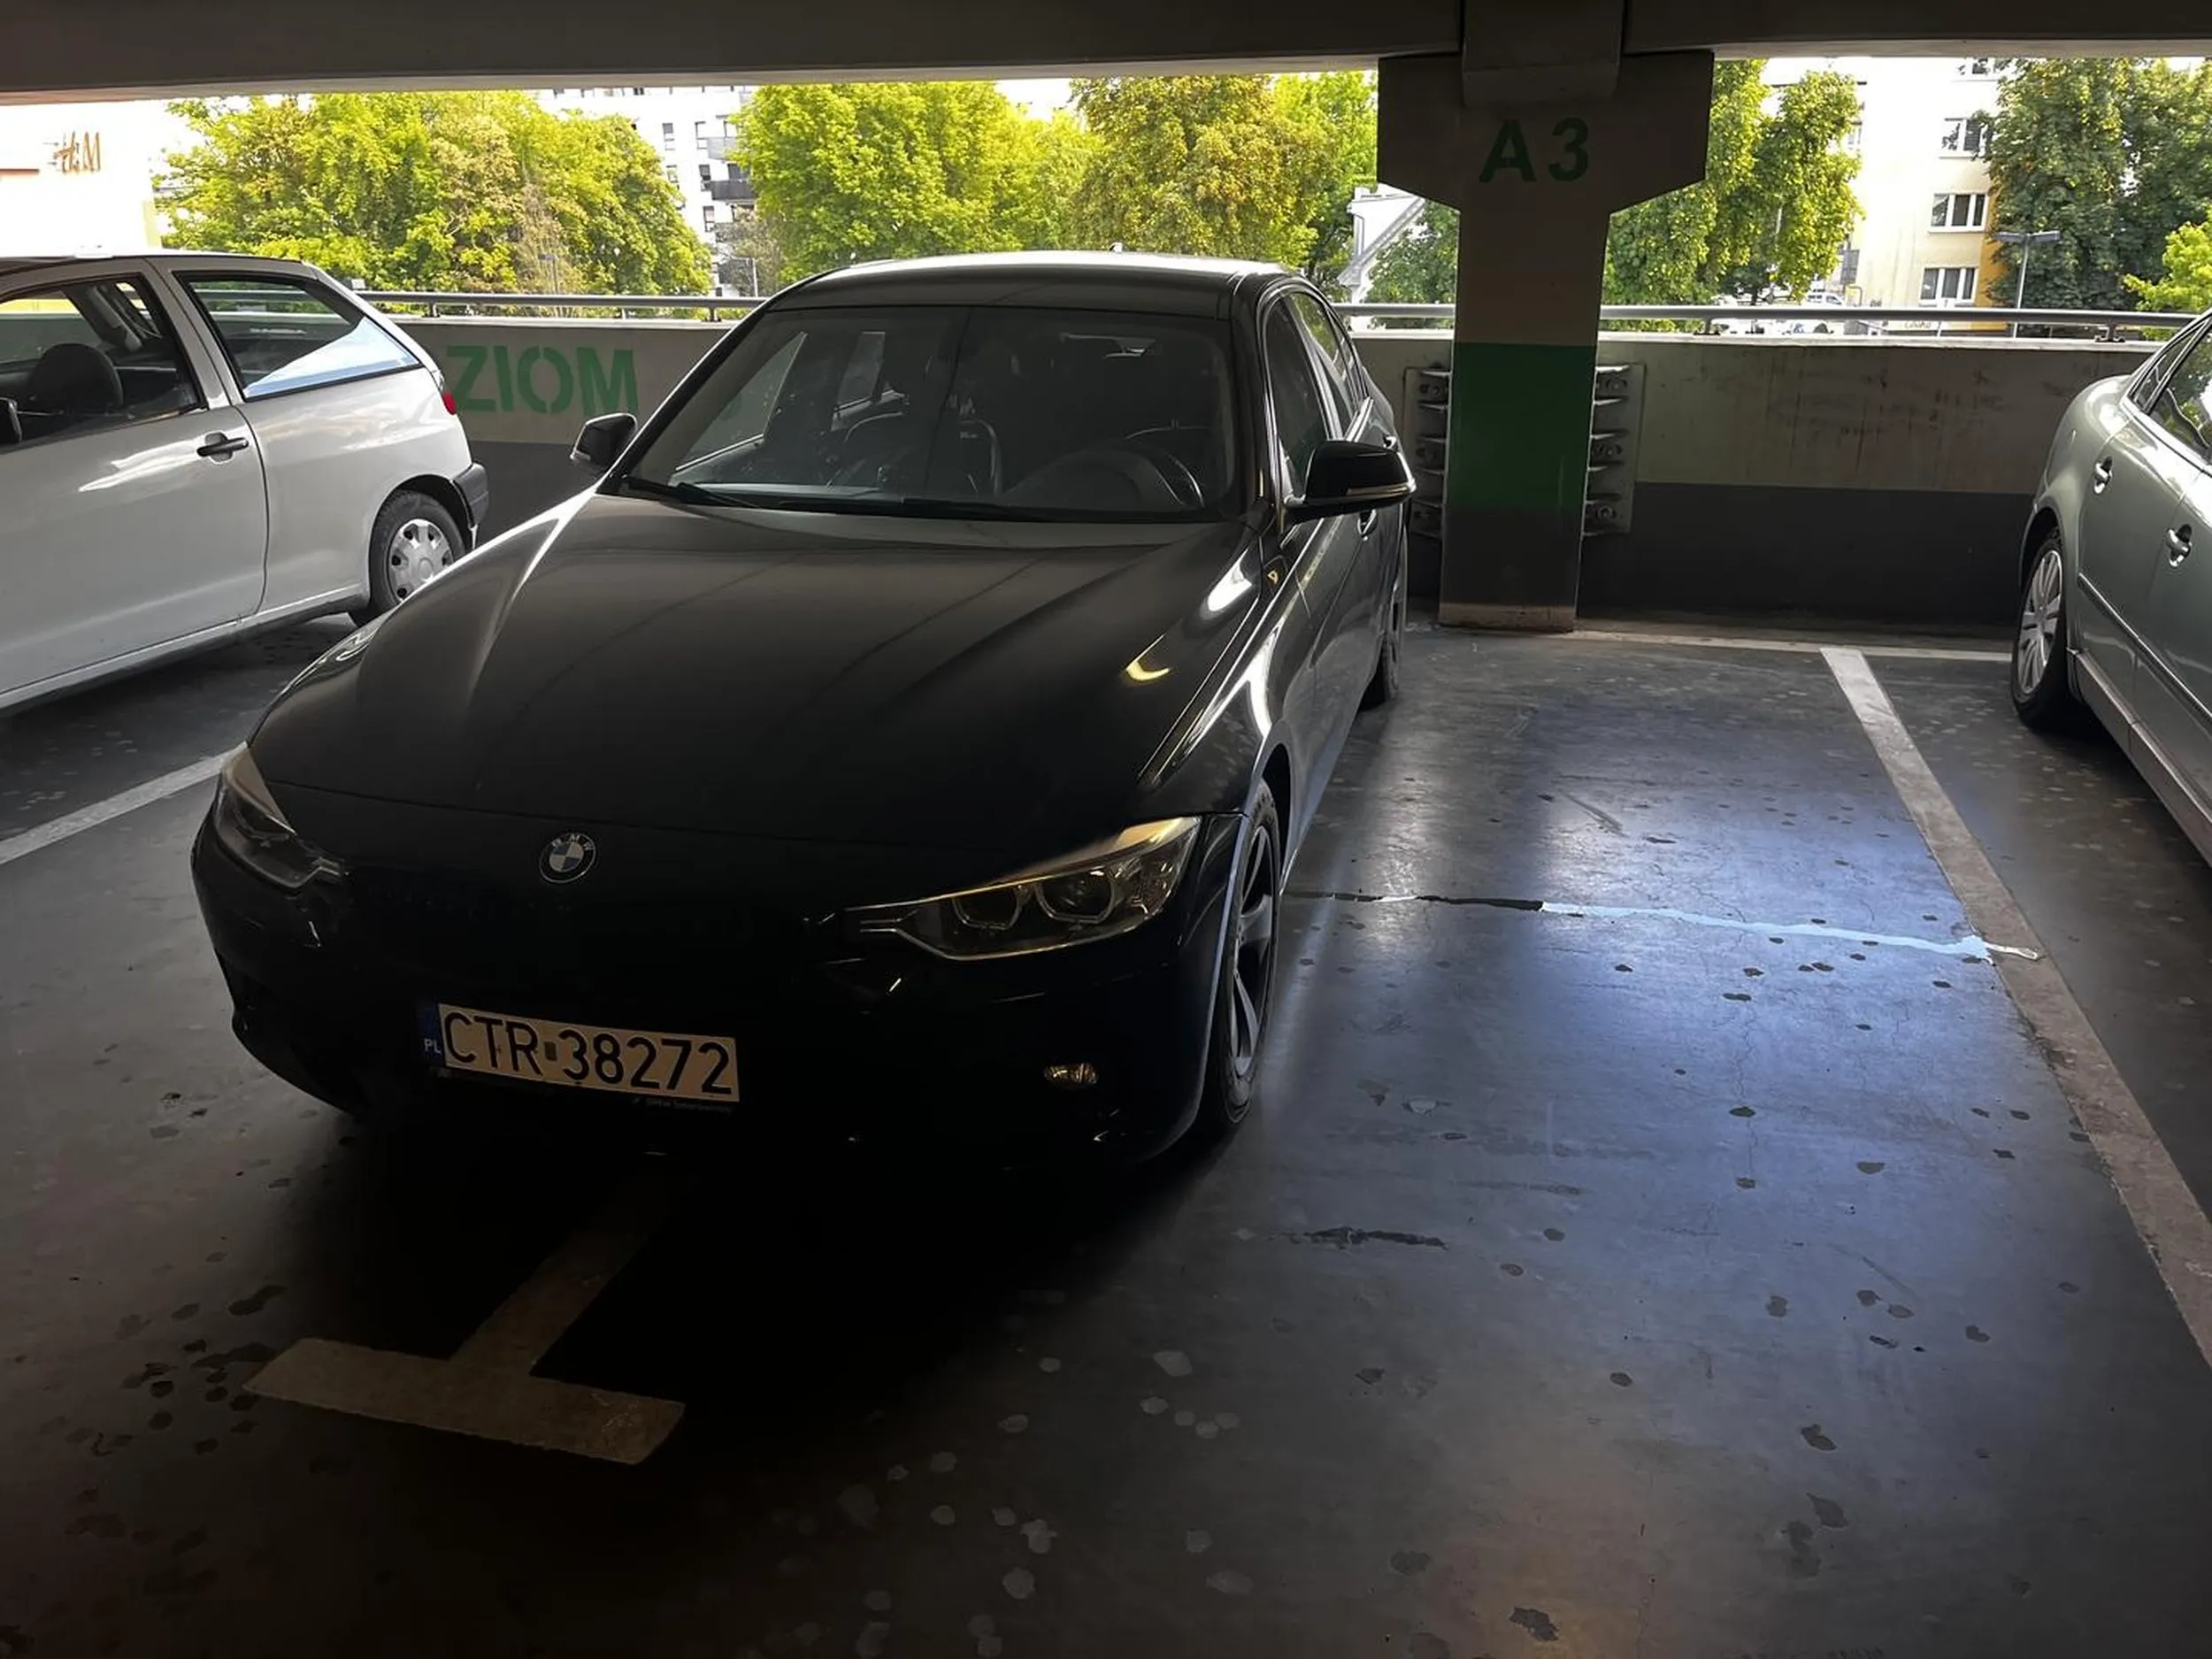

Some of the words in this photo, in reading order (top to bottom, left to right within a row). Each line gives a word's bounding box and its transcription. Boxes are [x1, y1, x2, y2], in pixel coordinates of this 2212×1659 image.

[423, 1037, 442, 1055] PL
[444, 1011, 542, 1077] CTR
[558, 1028, 733, 1095] 38272
